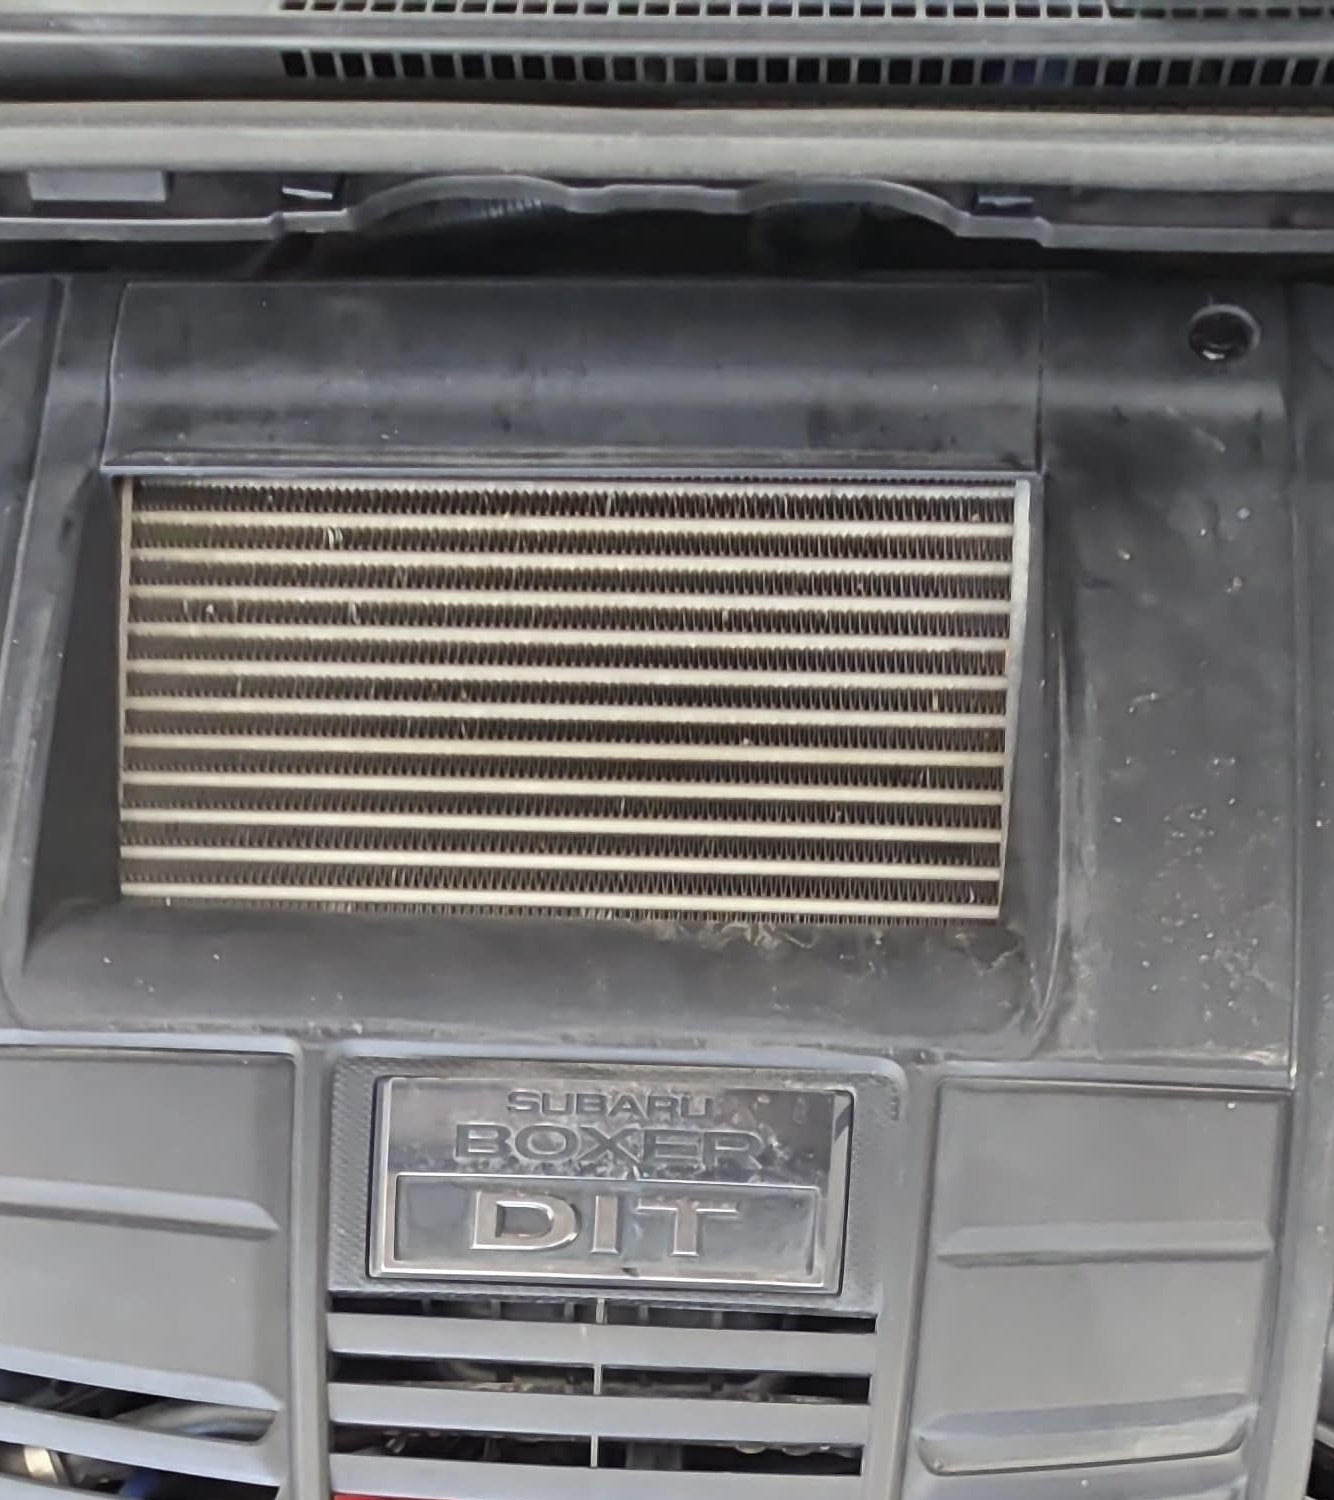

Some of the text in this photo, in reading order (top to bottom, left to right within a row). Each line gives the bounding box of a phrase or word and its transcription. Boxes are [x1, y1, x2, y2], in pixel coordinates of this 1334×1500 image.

[507, 1090, 715, 1120] SUBARU
[454, 1123, 765, 1168] BOXER
[469, 1189, 740, 1257] DIT
